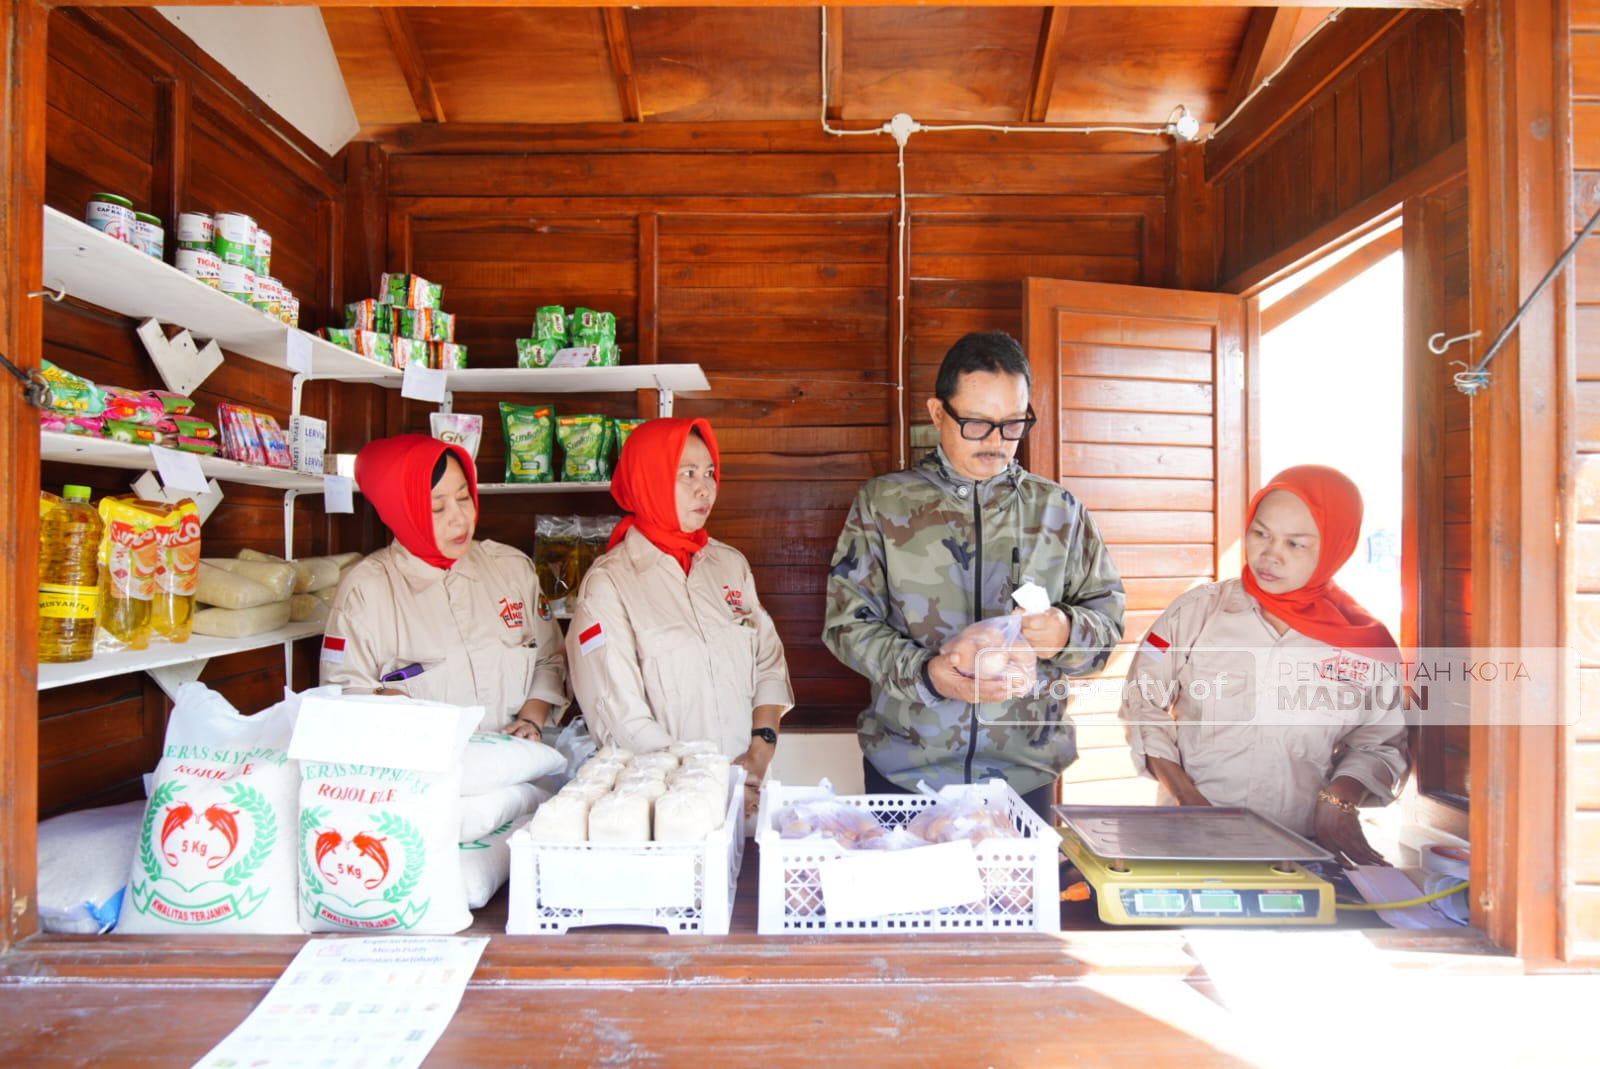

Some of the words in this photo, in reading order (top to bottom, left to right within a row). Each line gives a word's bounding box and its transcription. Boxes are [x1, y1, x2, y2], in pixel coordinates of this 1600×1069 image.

[164, 744, 208, 760] ERAS
[304, 762, 347, 781] ERAS
[181, 839, 189, 853] 5
[191, 840, 208, 857] Kg
[337, 863, 345, 874] 5
[346, 864, 362, 879] Kg
